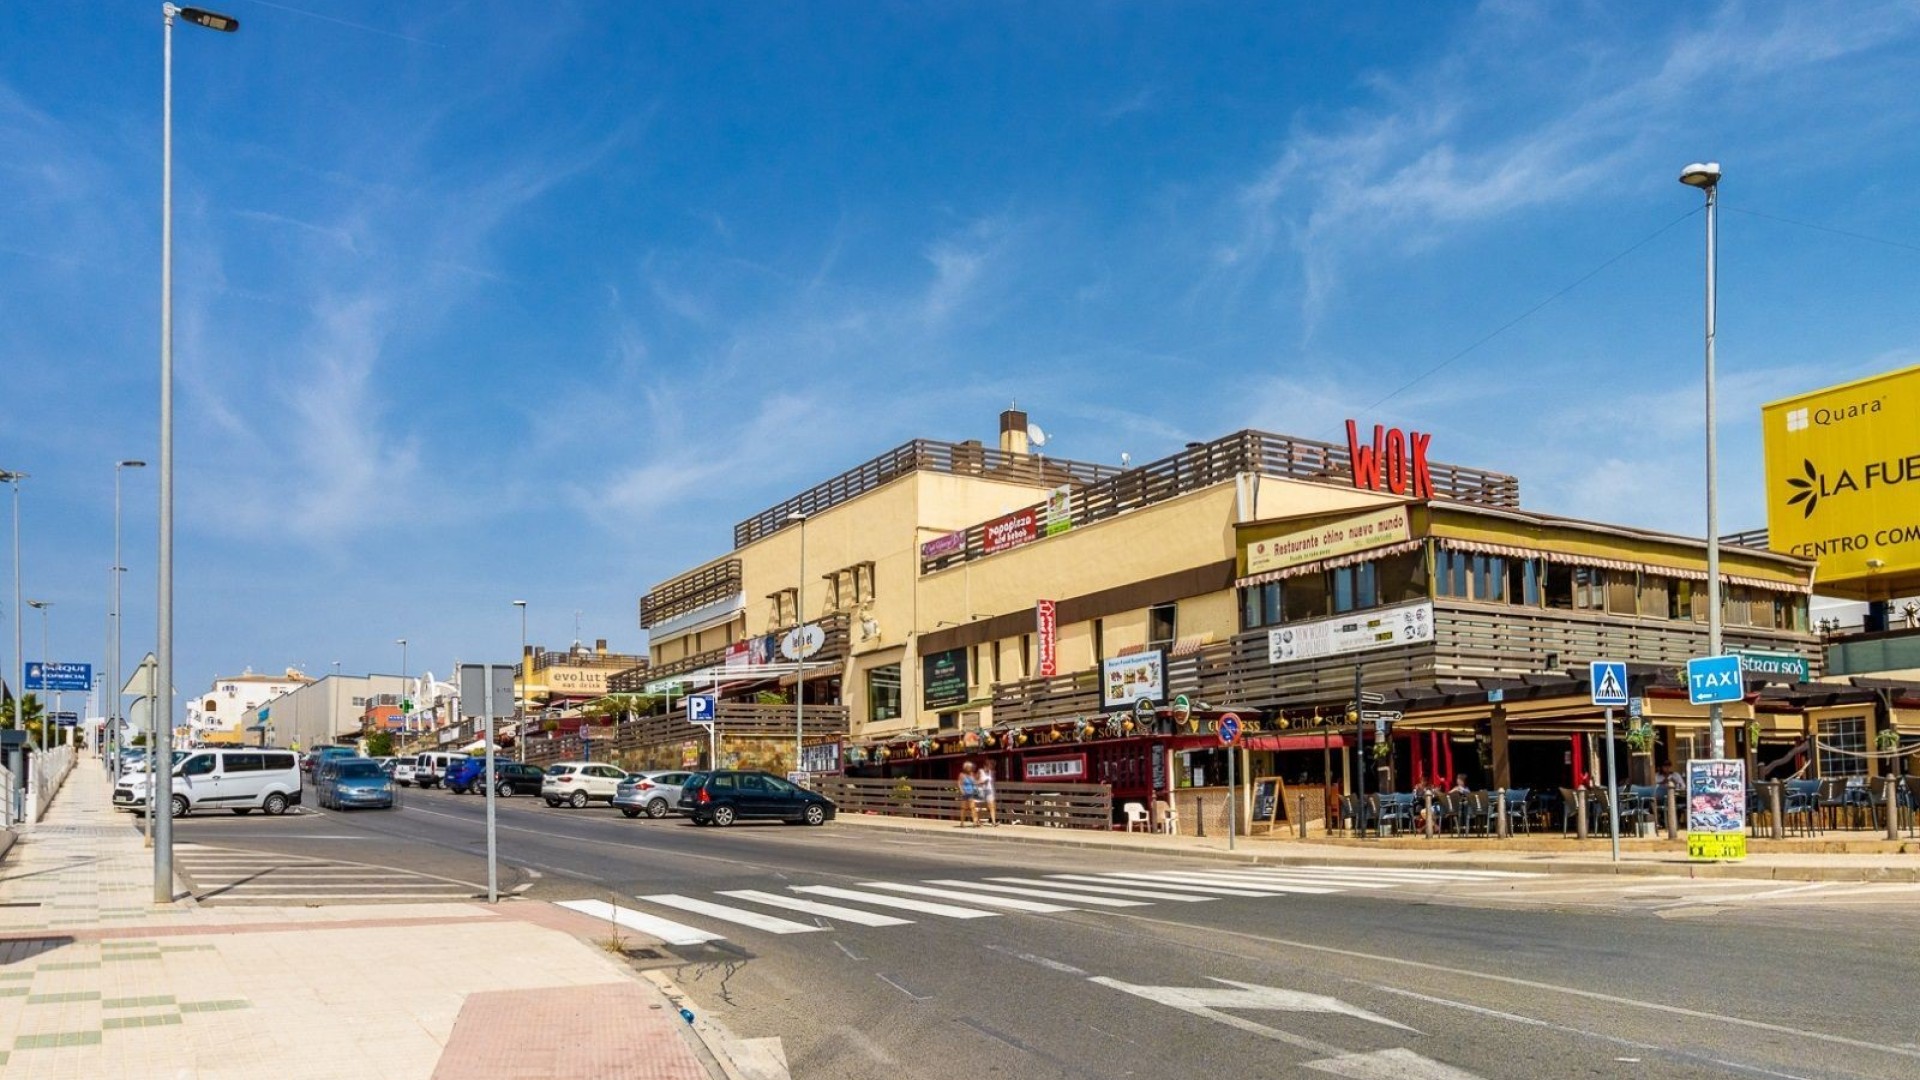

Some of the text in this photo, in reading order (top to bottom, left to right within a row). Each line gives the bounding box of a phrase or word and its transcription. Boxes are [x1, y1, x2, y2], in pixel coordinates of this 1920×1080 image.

[1814, 399, 1882, 425] Quara
[1345, 419, 1434, 498] WOK
[1820, 454, 1920, 497] LA FUE
[1274, 534, 1319, 556] Restaurante
[1323, 530, 1344, 544] chino
[1349, 524, 1373, 539] nuevo
[1378, 514, 1404, 531] mundo
[553, 671, 608, 682] evoluti
[1692, 671, 1738, 688] TAXI
[691, 698, 707, 719] P
